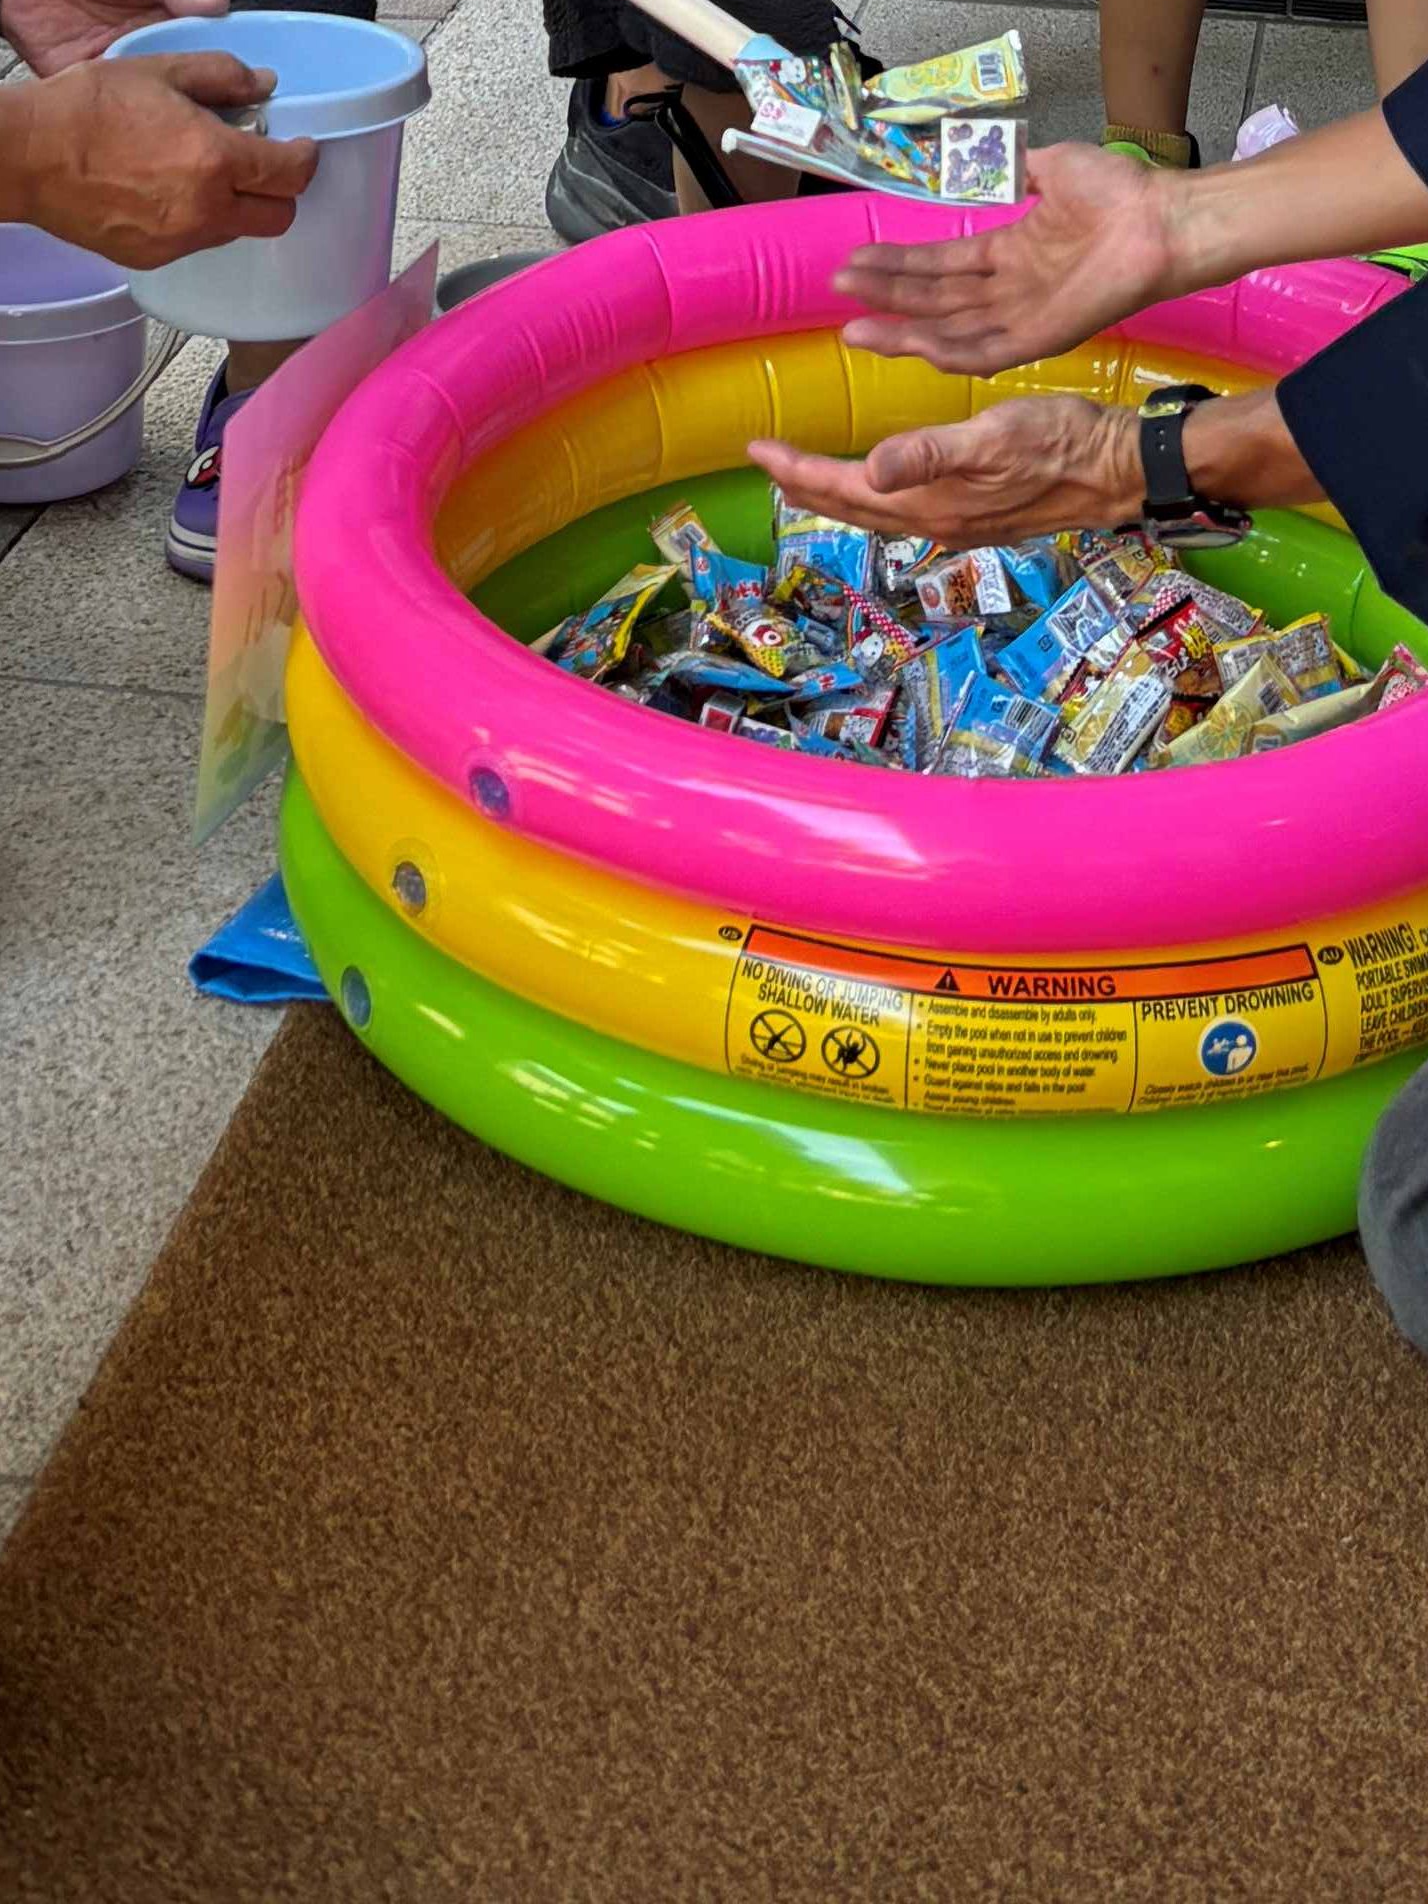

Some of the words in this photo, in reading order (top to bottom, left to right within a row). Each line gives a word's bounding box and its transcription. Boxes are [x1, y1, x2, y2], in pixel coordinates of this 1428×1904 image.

[1344, 921, 1419, 968] WARNING!
[742, 959, 763, 980] NO
[765, 964, 812, 993] DIVING
[815, 978, 837, 998] OR
[839, 983, 903, 1011] JUMPING
[988, 975, 1116, 996] WARNING
[1356, 959, 1403, 991] PORTABLE
[758, 983, 829, 1017] SHALLOW
[830, 1001, 881, 1027] WATER
[1141, 996, 1221, 1022] PREVENT
[1224, 982, 1315, 1015] DROWNING
[1361, 990, 1389, 1015] ADULT
